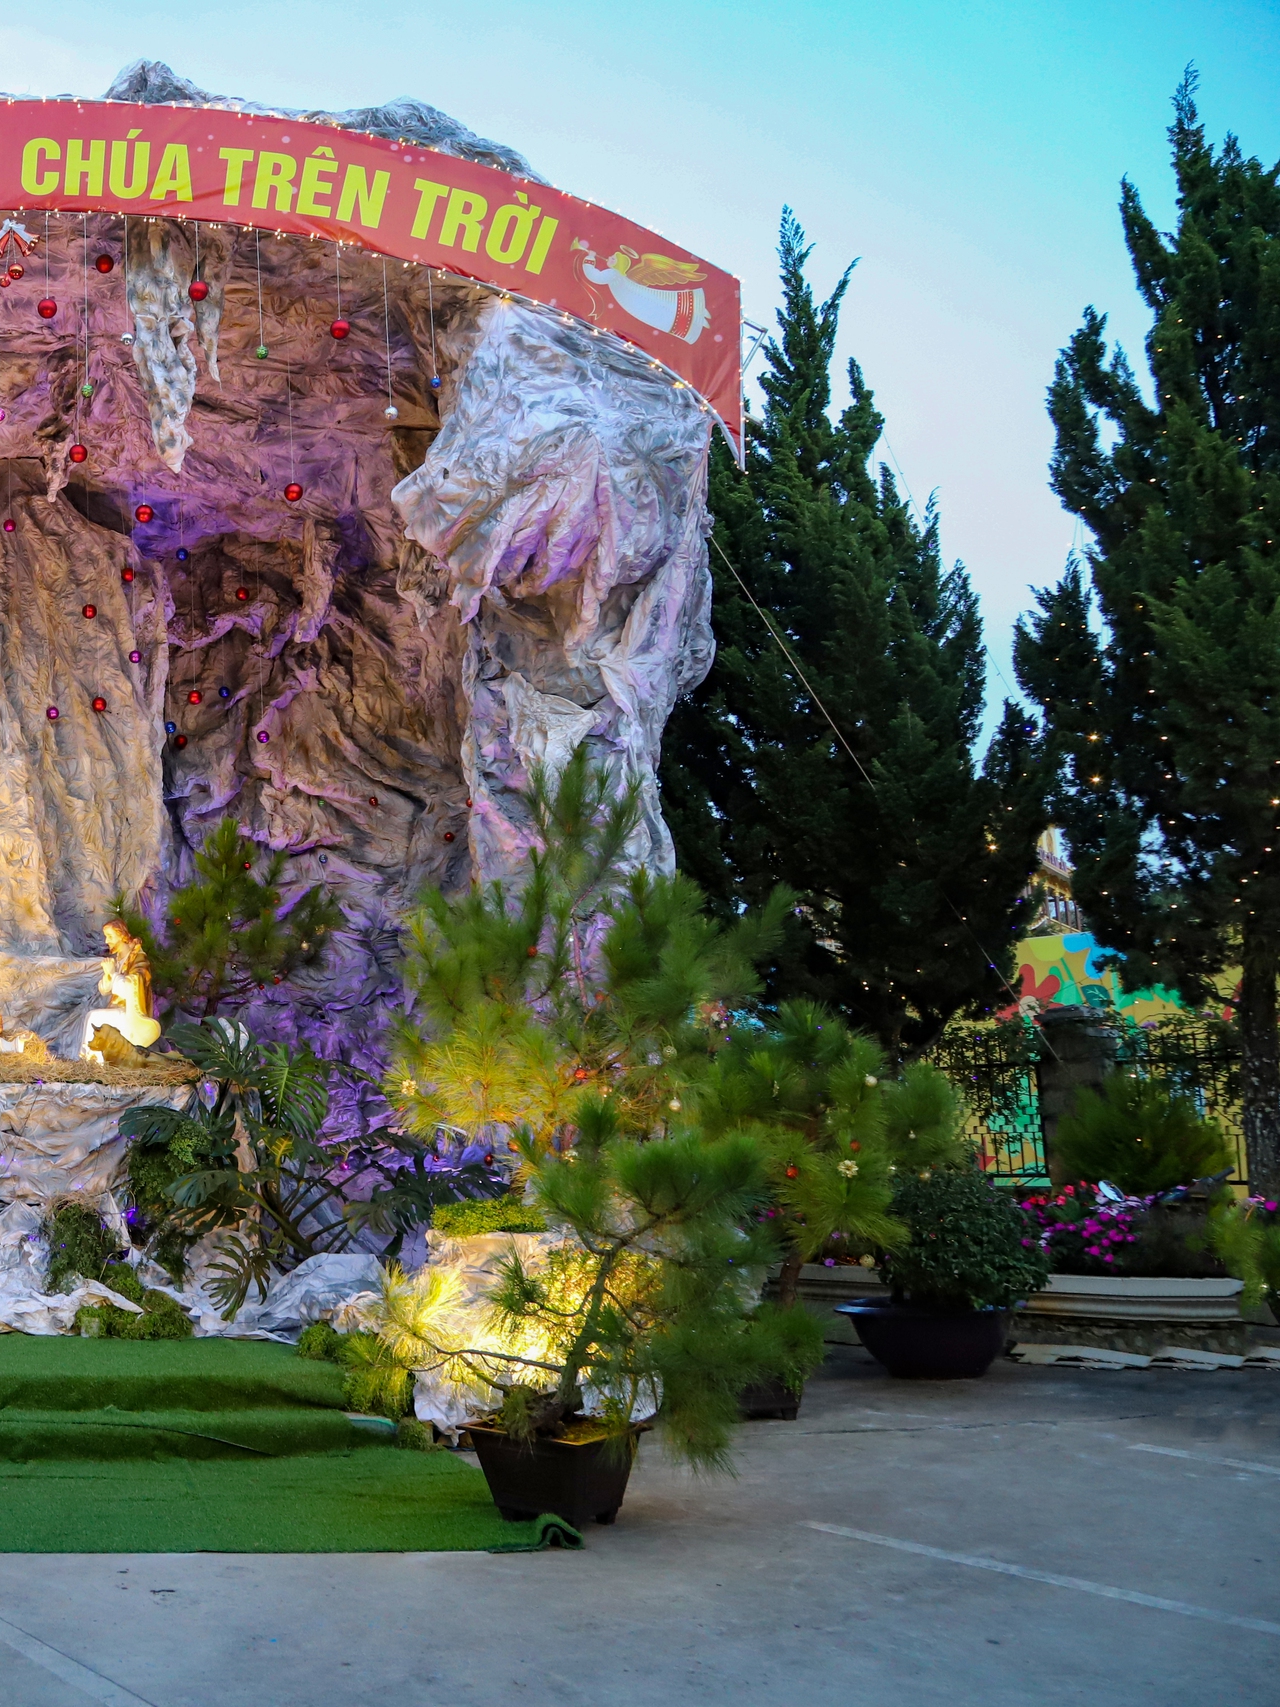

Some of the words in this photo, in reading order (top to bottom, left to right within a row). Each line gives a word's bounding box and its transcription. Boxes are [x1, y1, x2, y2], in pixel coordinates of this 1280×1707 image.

[20, 129, 194, 203] CHÚA
[218, 145, 392, 230] TRÊN
[410, 177, 560, 276] TRỜI
